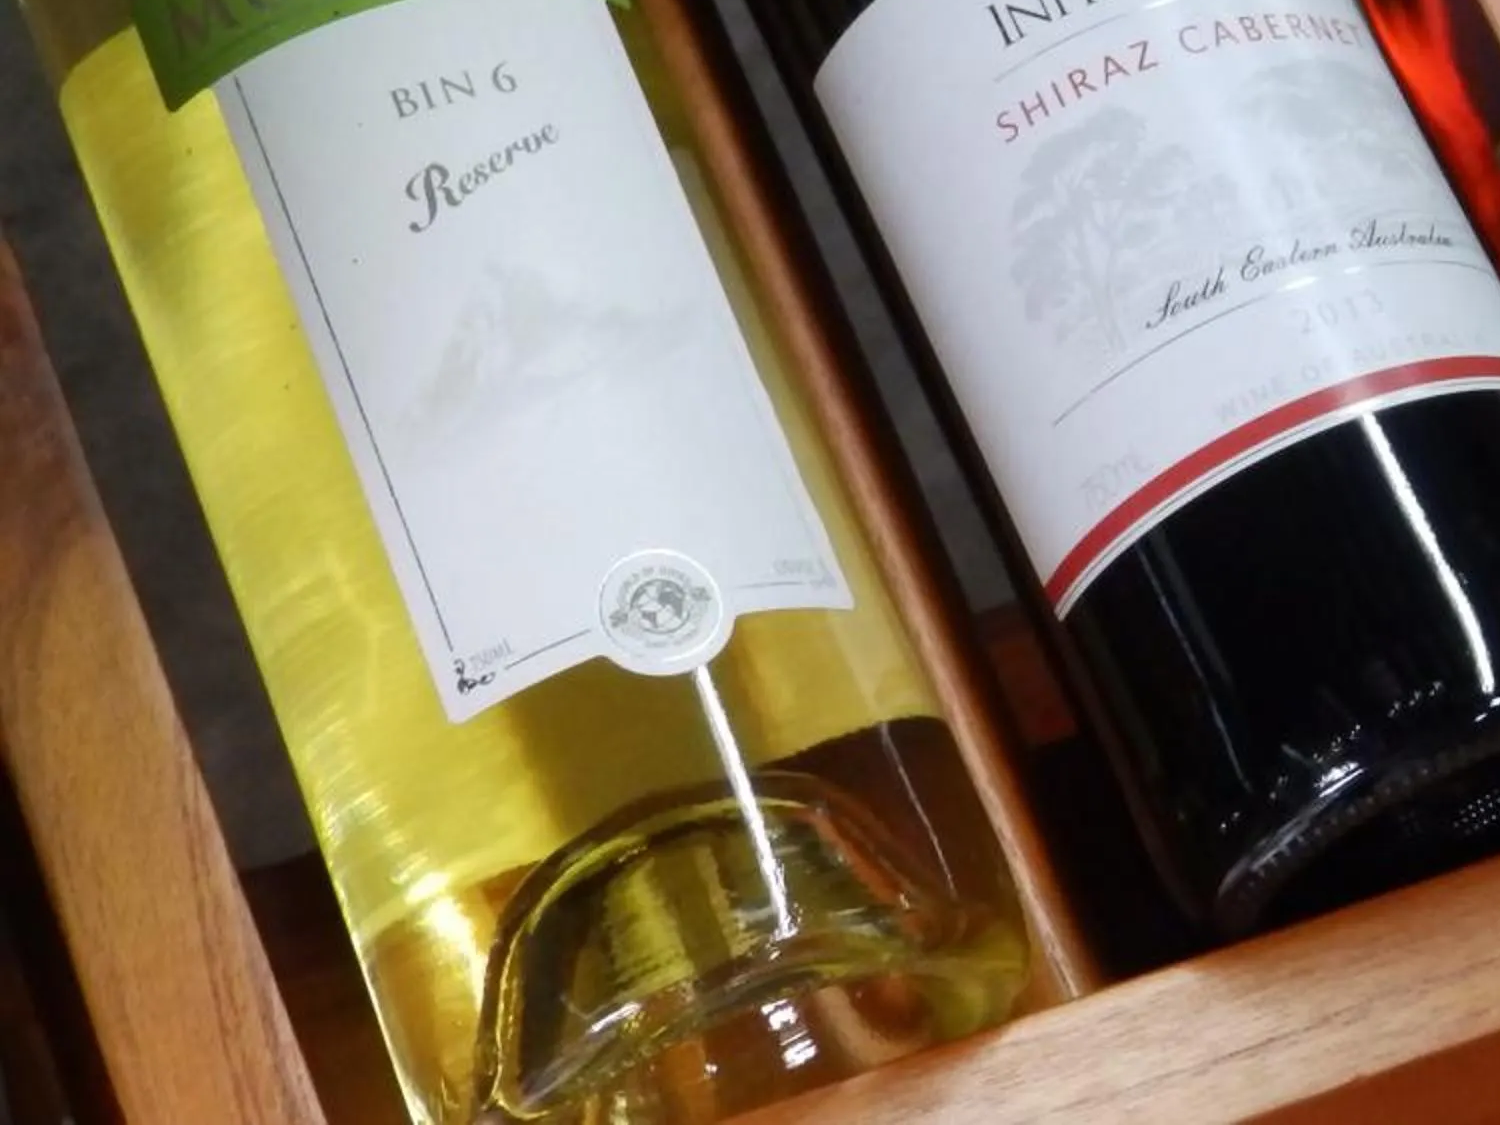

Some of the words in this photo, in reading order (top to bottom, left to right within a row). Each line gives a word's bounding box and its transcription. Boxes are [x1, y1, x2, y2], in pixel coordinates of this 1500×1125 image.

[389, 69, 475, 120] BIN
[492, 61, 518, 96] 6
[995, 39, 1161, 145] SHIRAZ
[1178, 8, 1368, 56] CABERNET
[405, 121, 561, 234] Reserve
[1145, 268, 1226, 329] South
[1240, 241, 1341, 283] Eastern
[1348, 218, 1453, 252] Australia
